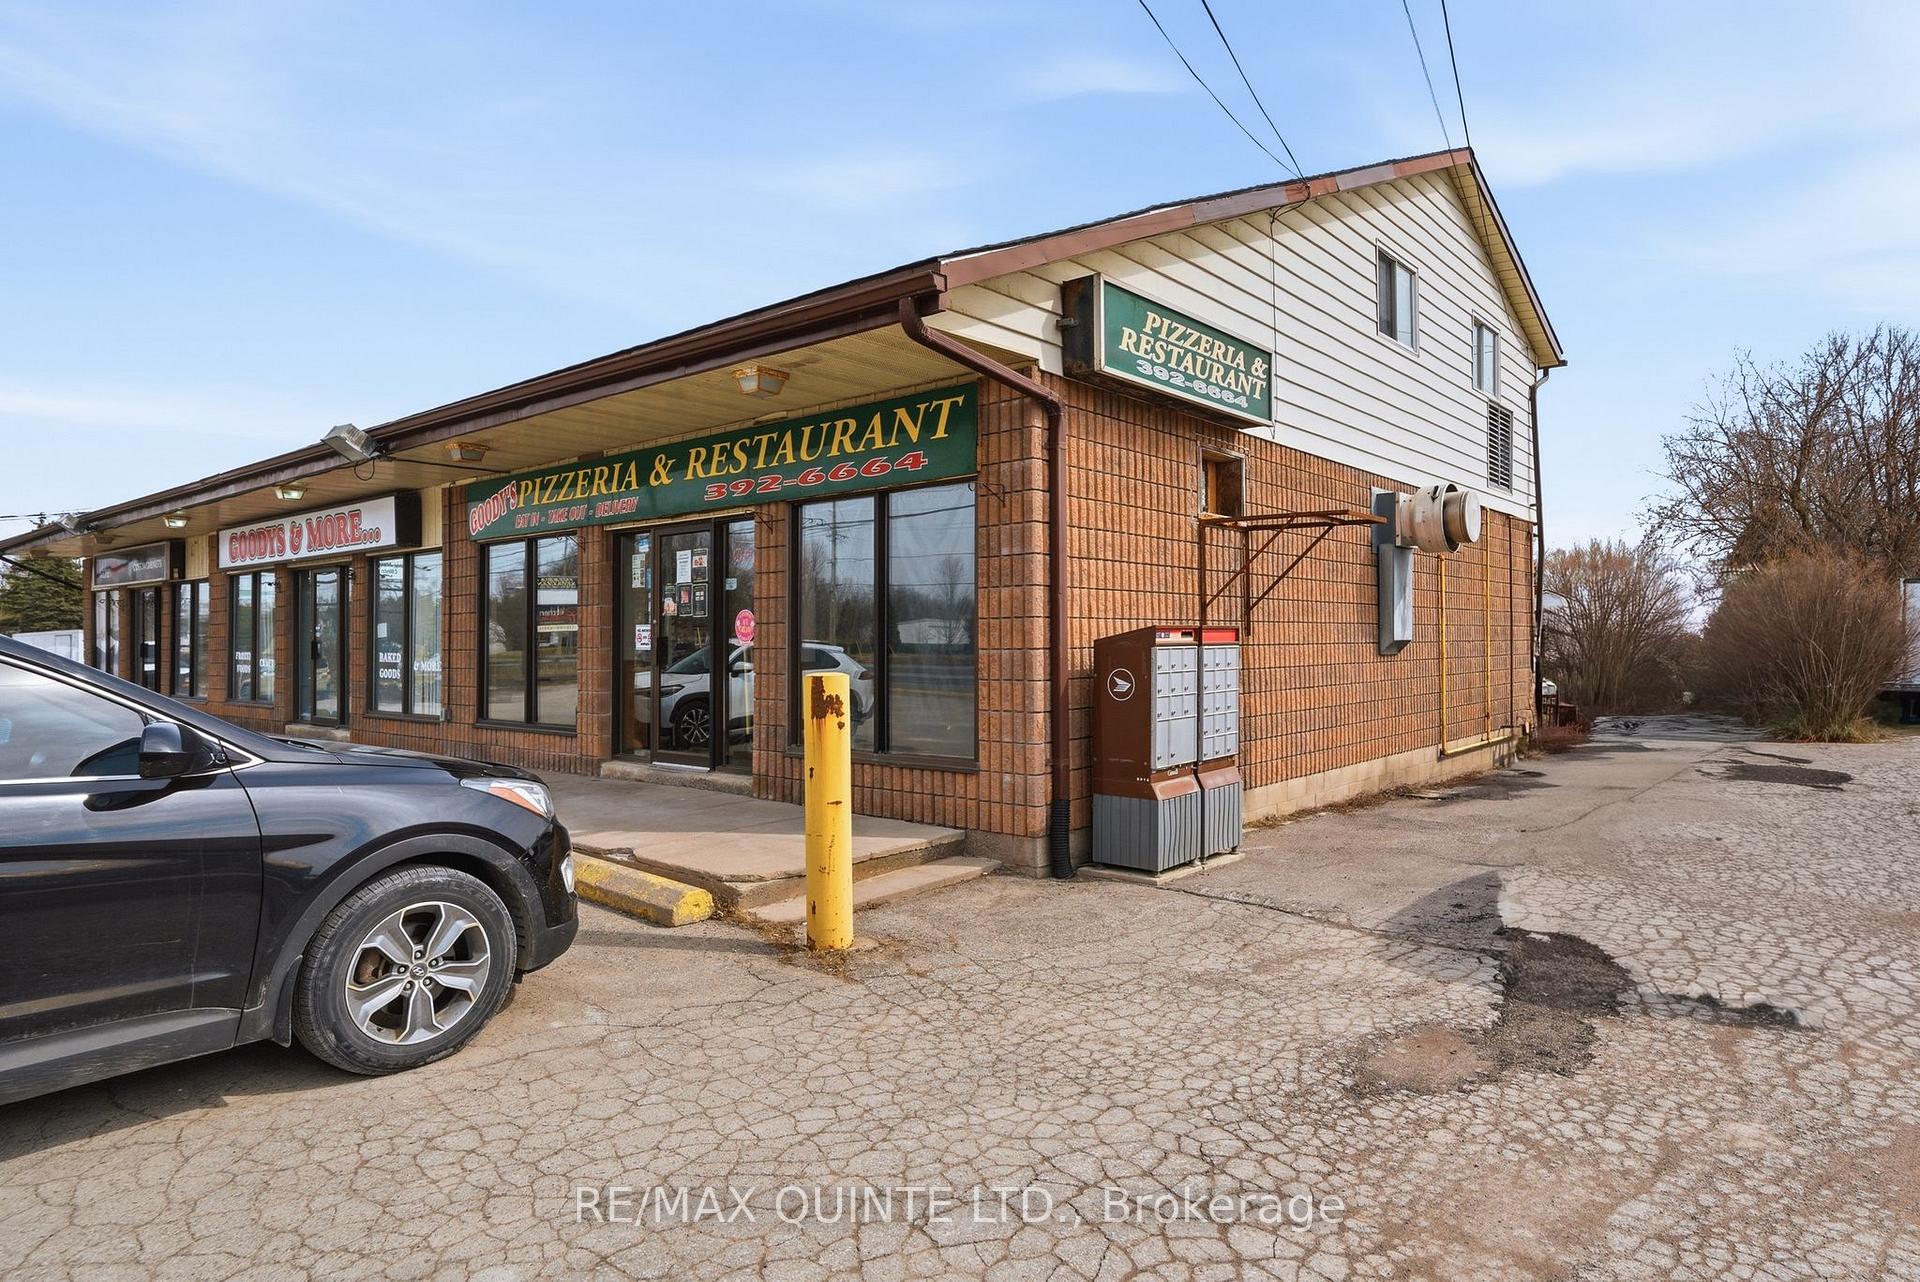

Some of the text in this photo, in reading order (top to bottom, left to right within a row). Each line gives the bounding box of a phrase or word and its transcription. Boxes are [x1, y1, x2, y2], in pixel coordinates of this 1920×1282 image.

[1118, 327, 1266, 400] RESTAURANT
[1142, 311, 1269, 379] PIZZERIA &
[1136, 359, 1249, 409] 392-6664
[517, 394, 965, 508] PIZZERIA & RESTAURANT
[704, 450, 928, 501] 392-6664
[469, 480, 519, 536] GOODY'S
[548, 508, 568, 524] TAKE
[569, 504, 588, 521] OUT
[594, 496, 639, 518] DELIVERY
[228, 523, 286, 563] GOODYS
[290, 520, 304, 554] &
[379, 652, 401, 663] BAKED
[379, 668, 401, 679] GOODS
[420, 660, 442, 672] MORE
